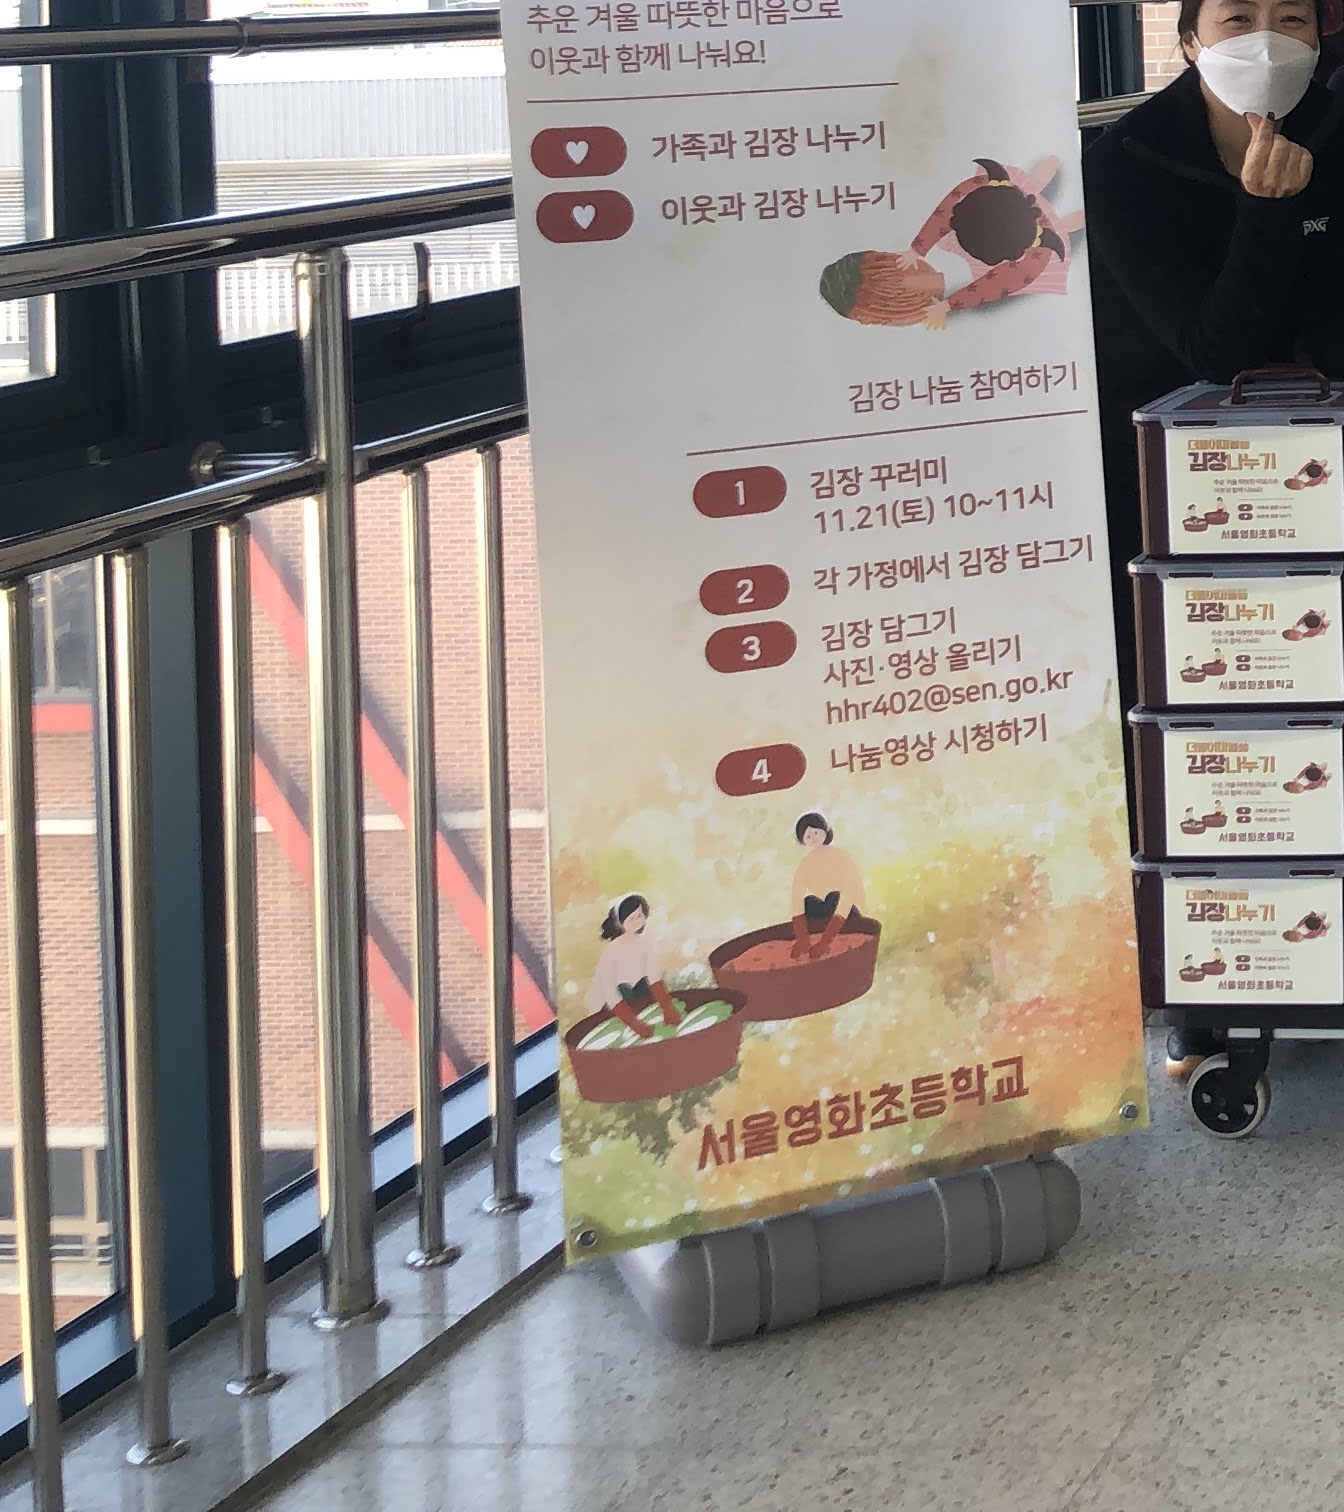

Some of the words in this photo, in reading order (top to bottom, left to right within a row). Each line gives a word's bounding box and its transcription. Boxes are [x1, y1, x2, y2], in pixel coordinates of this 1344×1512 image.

[526, 5, 579, 35] 추운
[587, 3, 640, 32] 겨울
[646, 0, 732, 30] 따뜻한
[530, 46, 610, 75] 이웃과
[616, 44, 671, 73] 함께
[677, 39, 766, 69] 나눠요!
[653, 132, 736, 163] 가족과
[744, 128, 798, 160] 김장
[807, 122, 887, 154] 나누기
[662, 194, 745, 225] 이웃과
[755, 190, 809, 221] 김장
[817, 183, 897, 215] 나누기
[850, 380, 903, 413] 김장
[911, 375, 963, 407] 나눔
[969, 361, 1078, 403] 참여하기
[1188, 450, 1276, 471] 김장나누기
[734, 481, 746, 505] 1
[811, 467, 864, 500] 김장
[871, 458, 948, 493] 꾸러미
[813, 494, 936, 535] 11.21(토)
[943, 482, 1054, 521] 10~11시
[813, 564, 840, 596] 각
[848, 552, 951, 591] 가정에서
[959, 547, 1008, 579] 김장
[1017, 535, 1094, 570] 담그기
[736, 579, 755, 604] 2
[1185, 601, 1274, 622] 김장나누기
[742, 636, 762, 661] 3
[821, 619, 873, 652] 김장
[880, 609, 956, 643] 담그기
[946, 636, 1022, 671] 올리기
[825, 666, 1073, 725] hhr402@sen.go.kr
[831, 735, 937, 774] 나눔영상
[944, 715, 1047, 756] 시청하기
[750, 759, 771, 784] 4
[1186, 753, 1275, 774] 김장나누기
[1186, 902, 1275, 922] 김장나누기
[697, 1055, 1029, 1171] 서울영화초등학교
